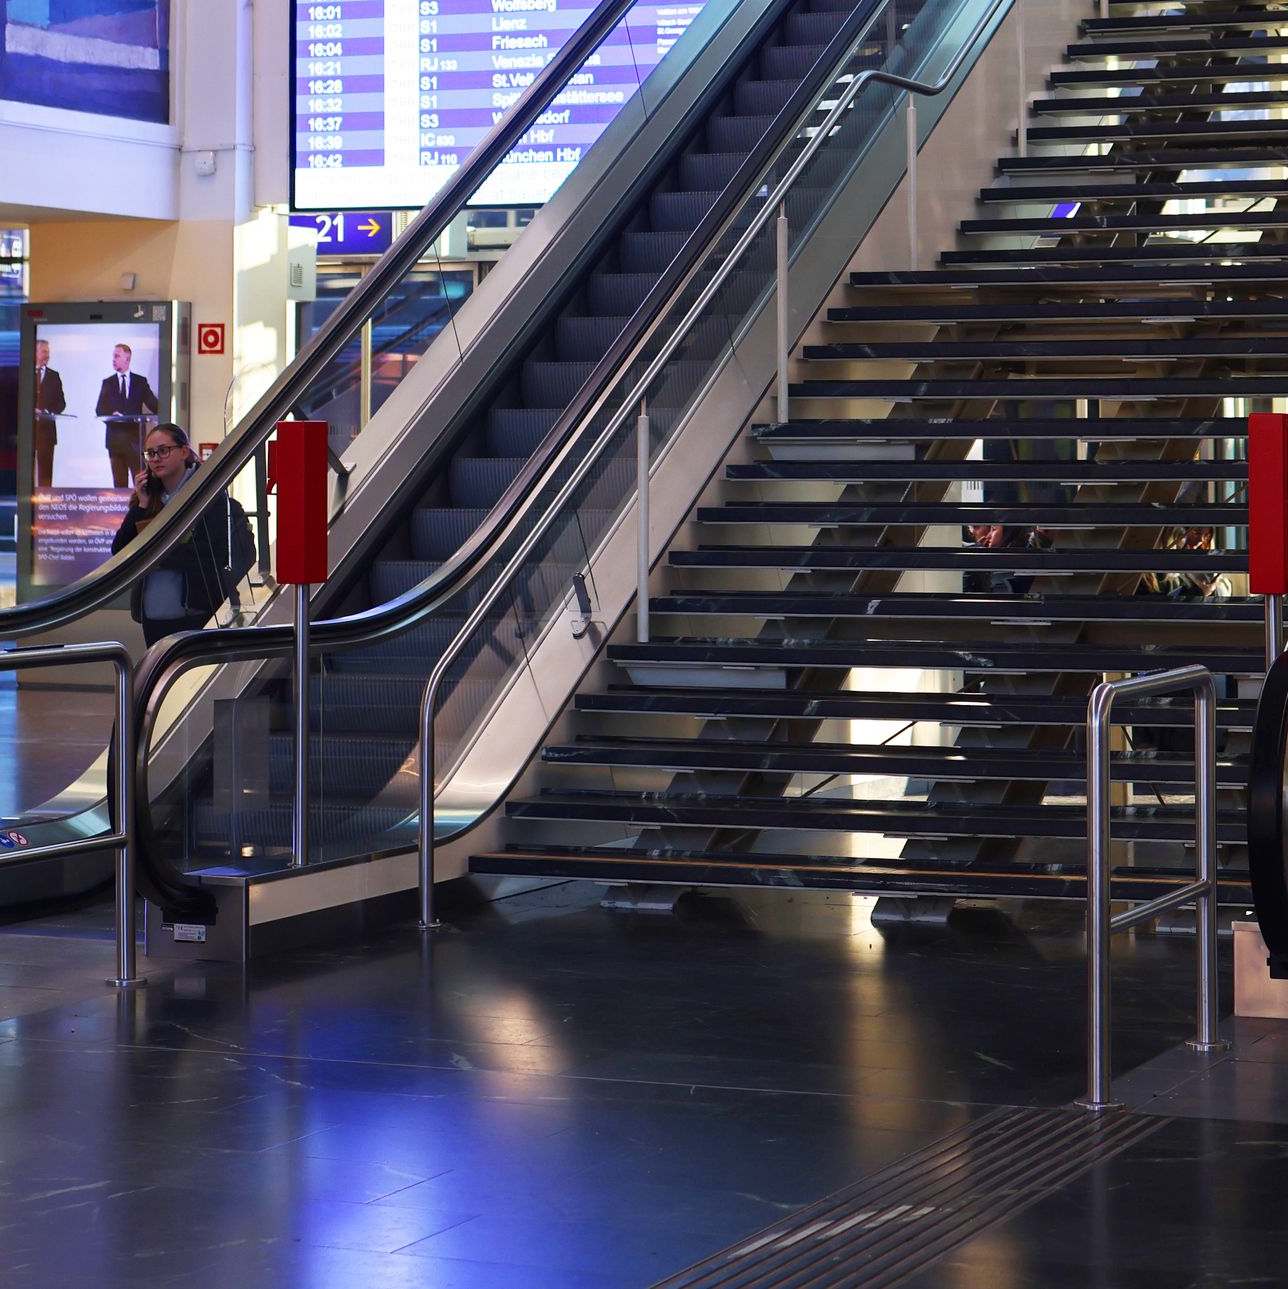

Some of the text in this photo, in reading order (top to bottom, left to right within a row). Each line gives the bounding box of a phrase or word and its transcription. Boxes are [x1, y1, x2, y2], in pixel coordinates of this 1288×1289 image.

[308, 5, 342, 21] 16:01
[420, 0, 439, 16] S3
[308, 16, 528, 39] 16:02 S1 Lienz
[308, 33, 548, 58] 16:04 S1 Friesach
[308, 60, 342, 76] 16:21
[420, 57, 439, 72] RJ
[491, 54, 544, 70] Venezia
[420, 75, 438, 91] S1
[420, 94, 438, 110] S1
[420, 113, 439, 129] S3
[420, 151, 439, 166] RJ
[503, 149, 554, 163] ünchen
[315, 213, 345, 243] 21
